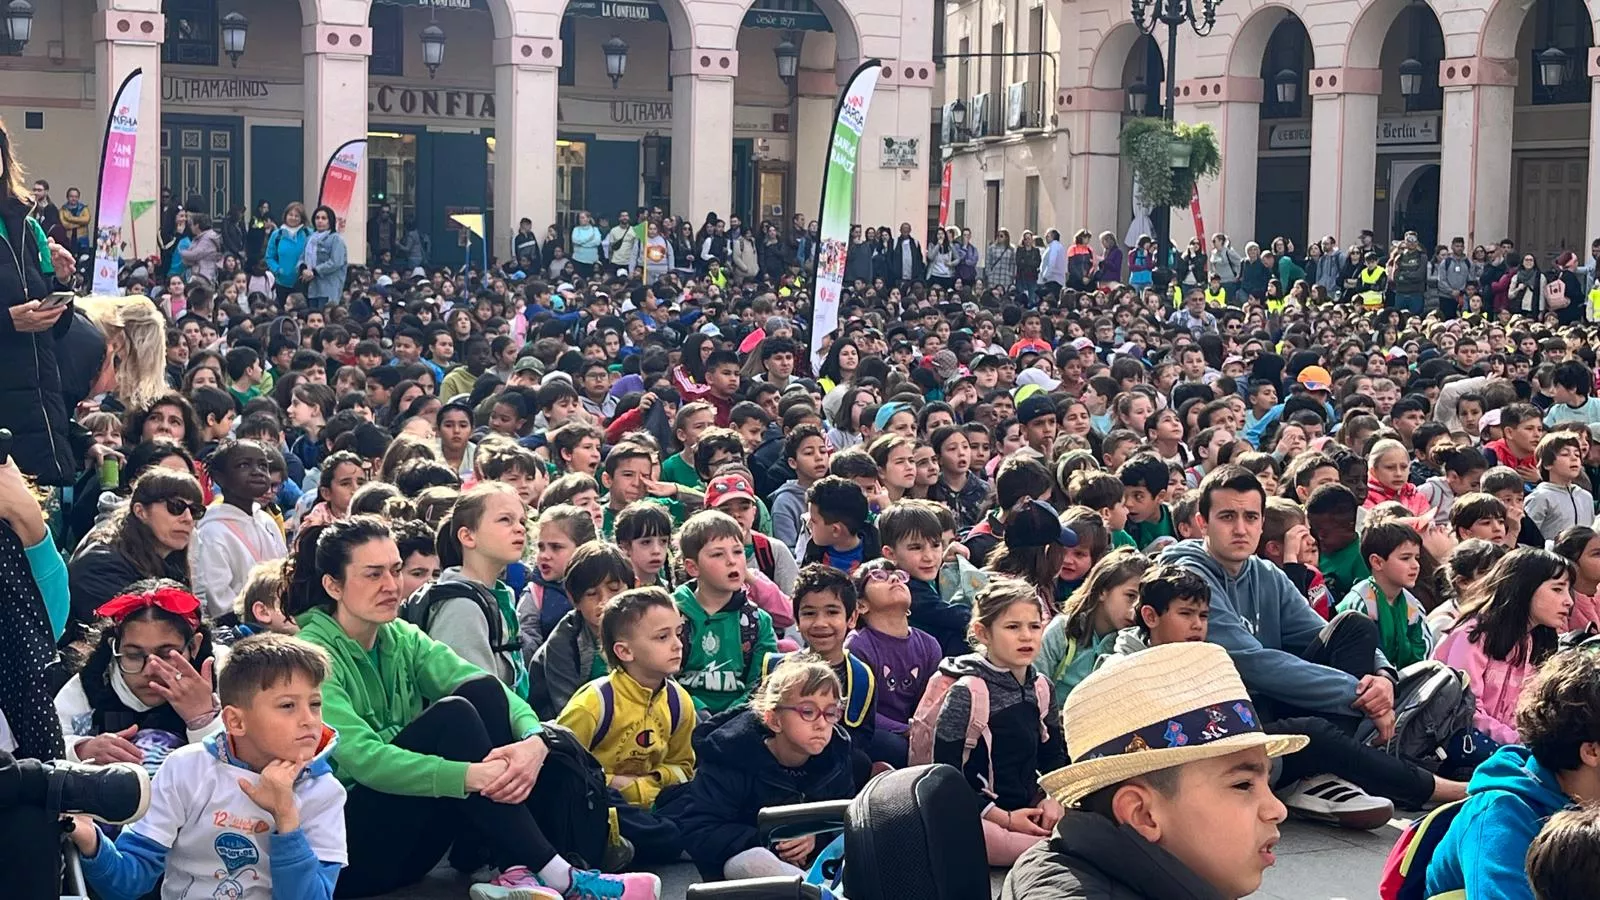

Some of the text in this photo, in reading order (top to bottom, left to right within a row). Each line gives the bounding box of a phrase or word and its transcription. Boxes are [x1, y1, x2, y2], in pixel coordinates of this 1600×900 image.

[601, 2, 611, 17] LA
[612, 3, 650, 19] CONFIANZA
[161, 76, 269, 100] ULTRAMARINOS
